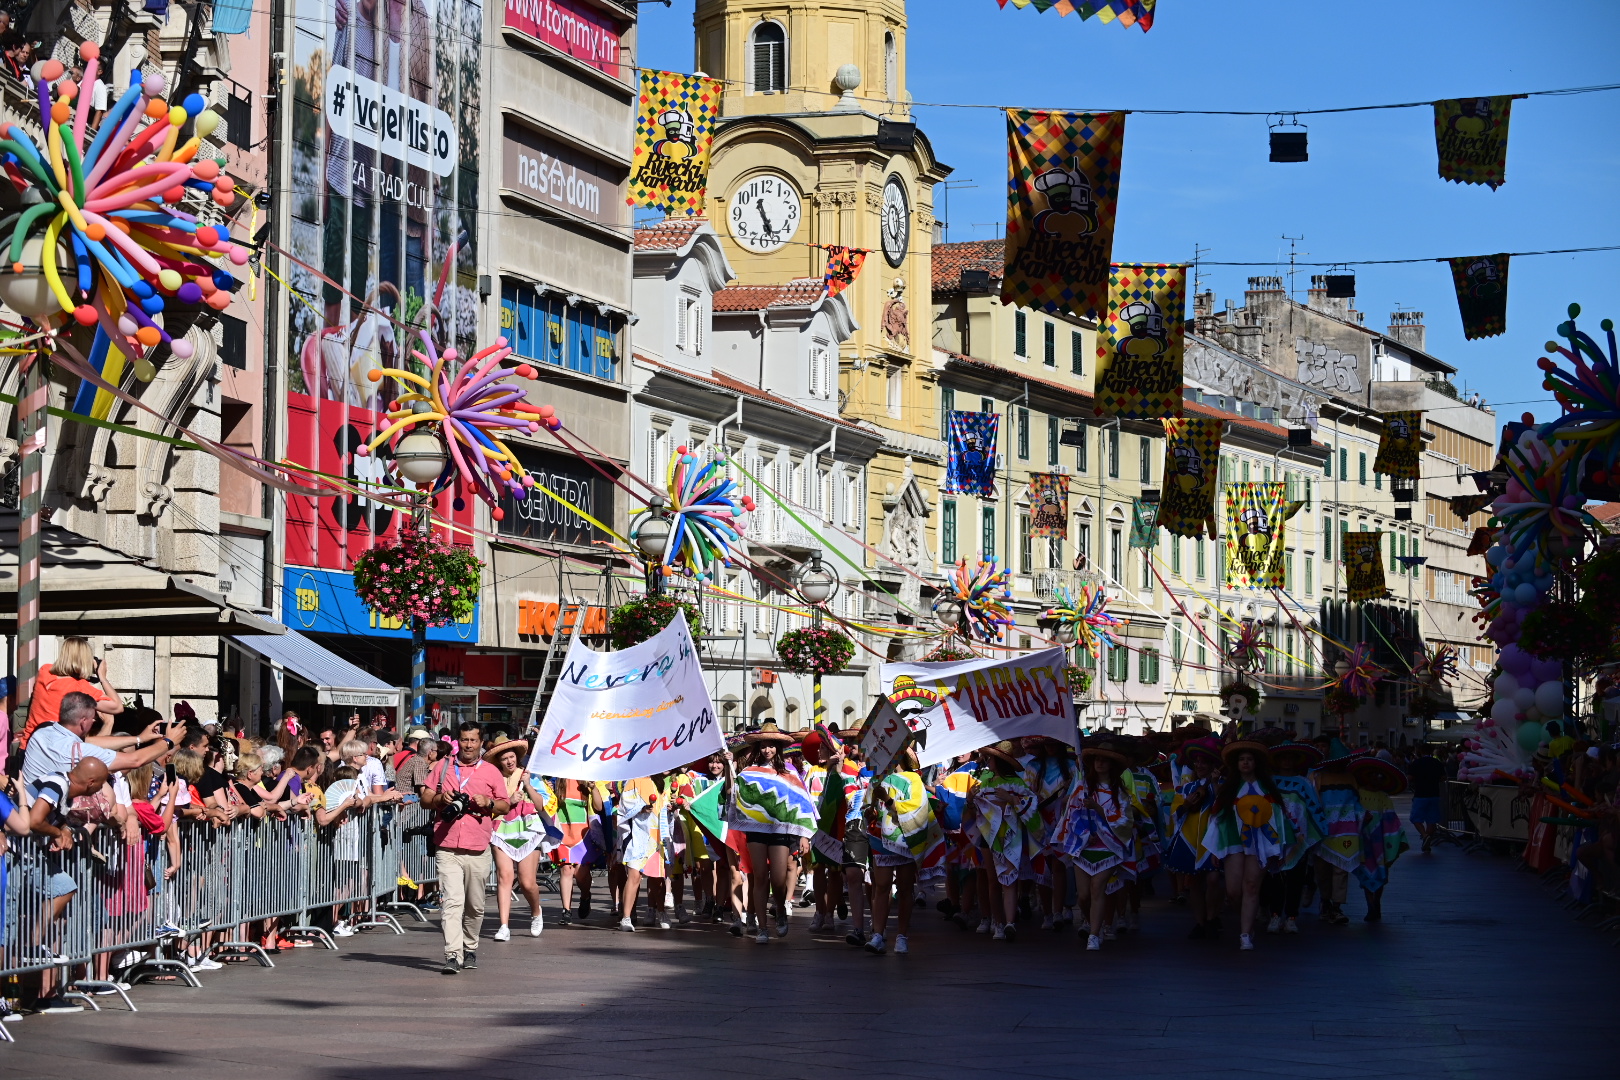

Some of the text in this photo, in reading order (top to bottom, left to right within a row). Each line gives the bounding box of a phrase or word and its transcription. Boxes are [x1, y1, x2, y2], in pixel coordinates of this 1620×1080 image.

[504, 0, 617, 63] ww.tommy.hr
[518, 151, 600, 215] naš dom
[749, 182, 758, 198] 11
[761, 179, 773, 194] 12
[777, 182, 782, 198] 1
[738, 190, 750, 205] 10
[783, 189, 791, 204] 2
[733, 206, 742, 221] 9
[788, 204, 797, 220] 3
[738, 221, 747, 237] 8
[781, 219, 791, 234] 4
[749, 231, 758, 246] 7
[759, 233, 769, 249] 6
[771, 230, 782, 246] 5
[516, 468, 592, 531] CENTRA
[295, 587, 320, 612] TEDi
[560, 654, 675, 688] Nevera
[550, 707, 713, 762] Kvarnera
[883, 718, 898, 738] 2
